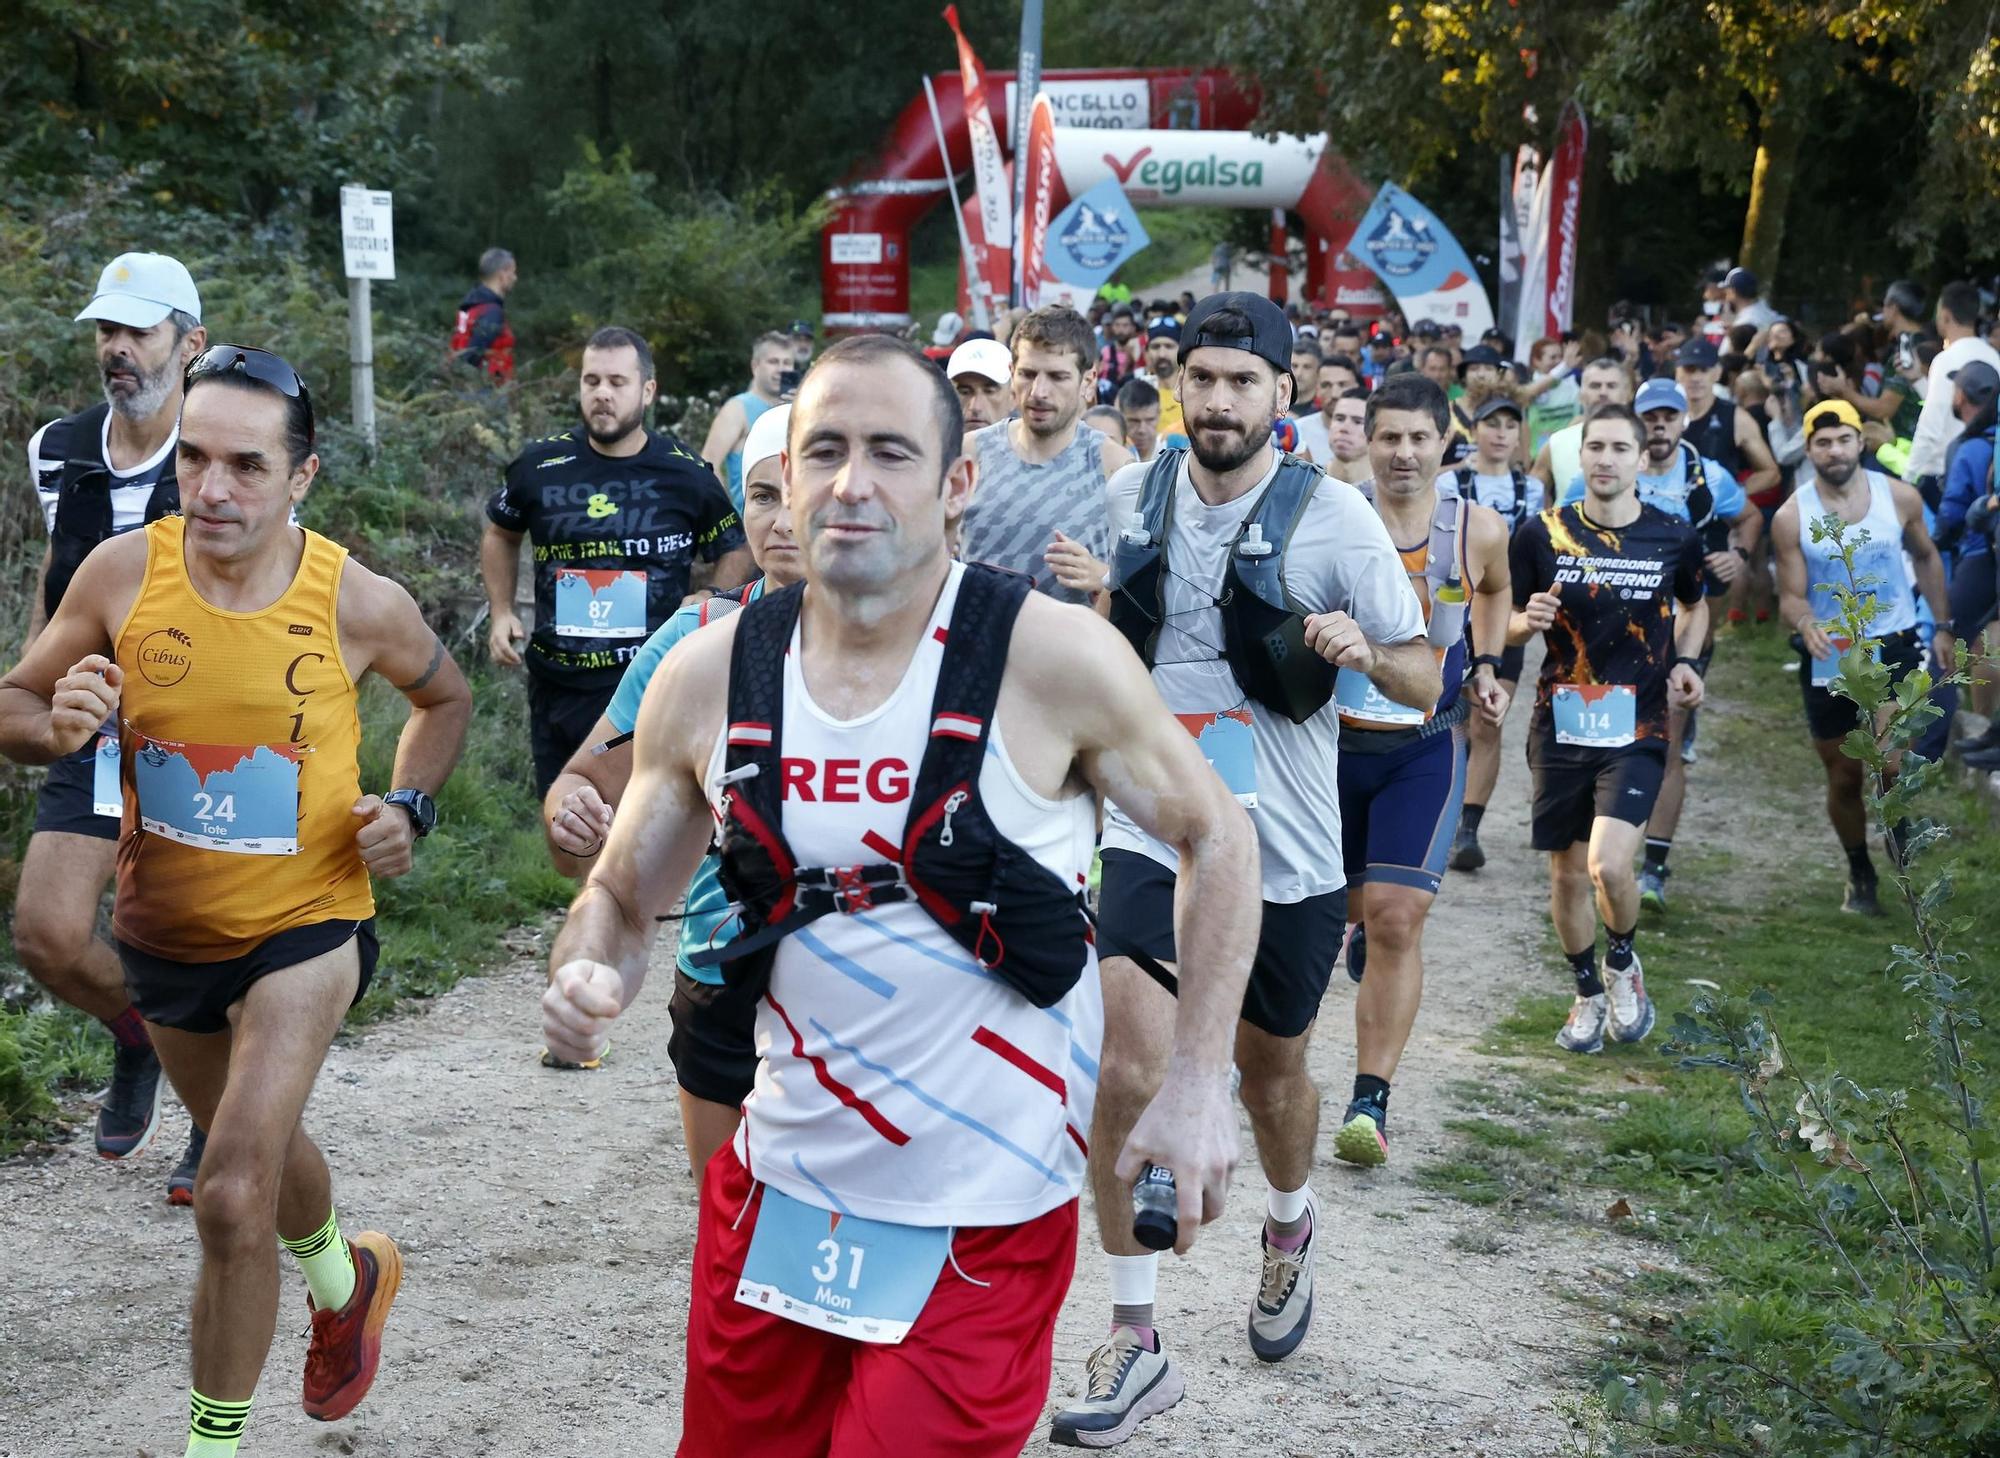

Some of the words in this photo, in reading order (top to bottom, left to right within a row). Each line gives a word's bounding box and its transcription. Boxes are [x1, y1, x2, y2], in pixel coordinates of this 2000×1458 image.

[1103, 146, 1263, 195] Vegalsa
[541, 478, 661, 508] ROCK
[587, 493, 619, 518] &
[541, 505, 673, 540] TRAIL
[580, 539, 623, 558] TRAIL
[622, 538, 650, 556] TO
[657, 531, 692, 553] HELL
[1556, 555, 1576, 566] OS
[1576, 556, 1663, 571] CORREDORES
[1554, 569, 1581, 583] DO
[1582, 571, 1663, 588] INFERNO
[588, 600, 613, 619] 87
[142, 648, 187, 667] Cibus
[1578, 712, 1610, 730] 114
[780, 757, 910, 803] REG
[192, 792, 237, 822] 24
[201, 822, 228, 836] Tote
[811, 1238, 865, 1290] 31
[814, 1285, 852, 1311] Mon
